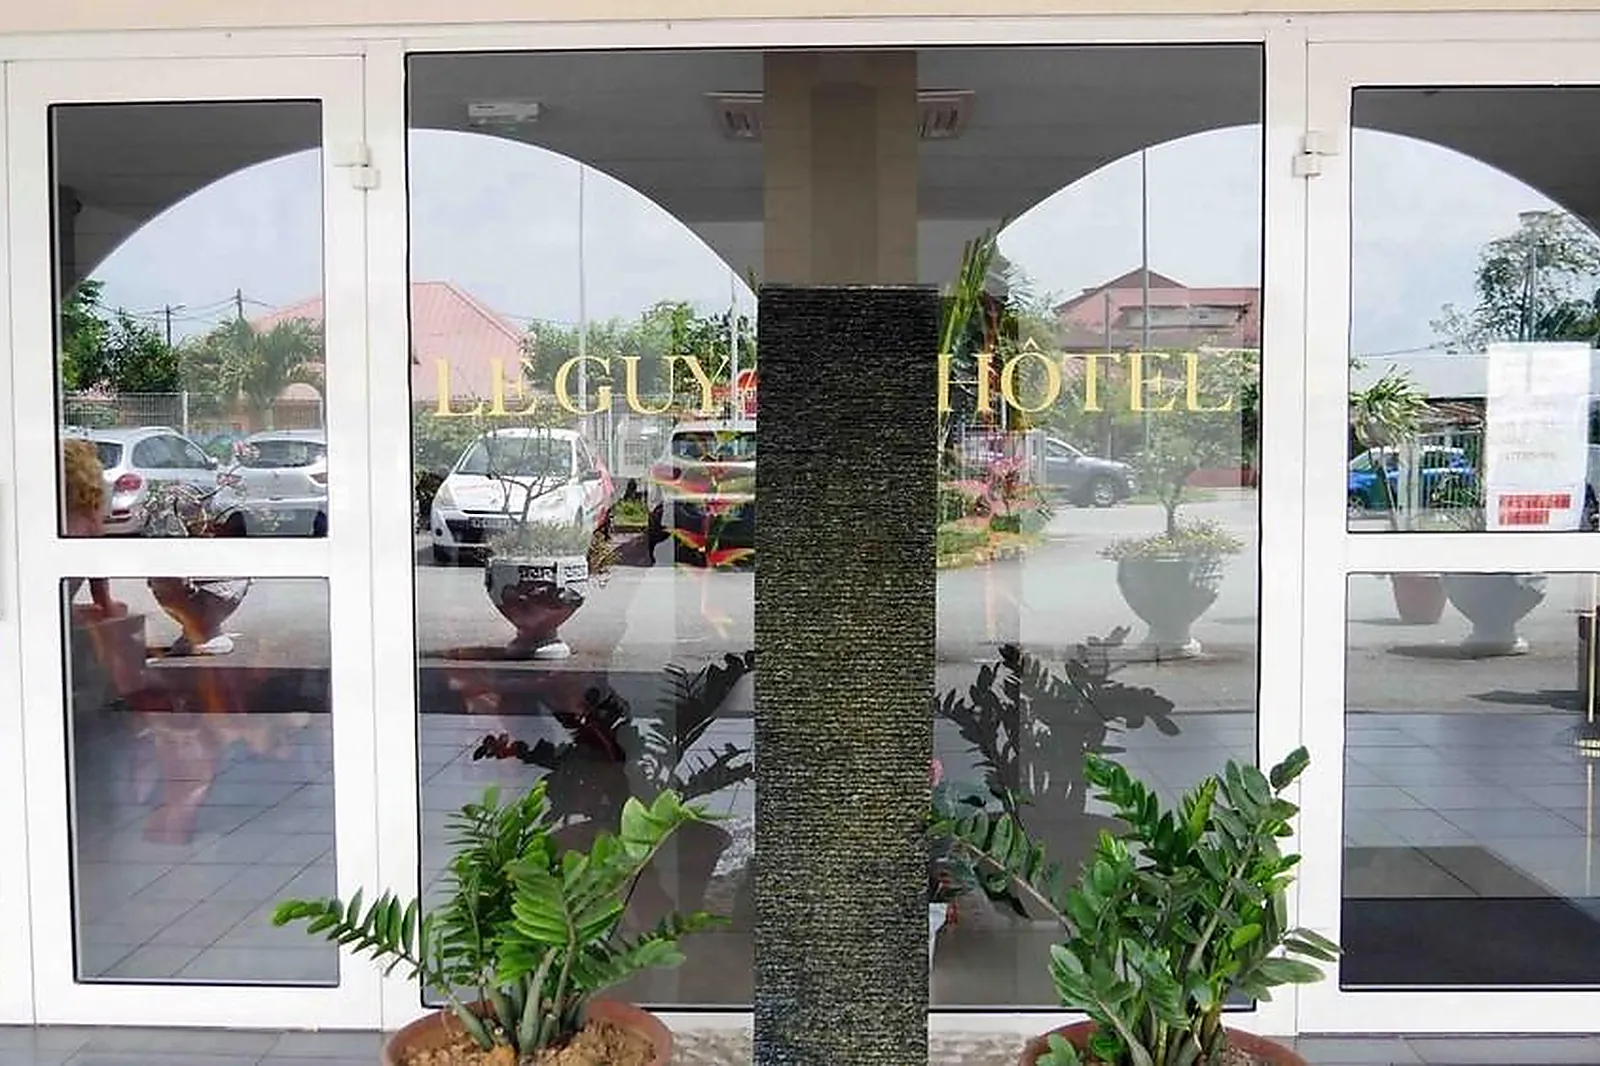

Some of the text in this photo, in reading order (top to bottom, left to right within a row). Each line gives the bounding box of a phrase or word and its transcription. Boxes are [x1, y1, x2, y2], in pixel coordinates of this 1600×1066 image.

[433, 337, 1234, 418] LE GUY HÔTEL
